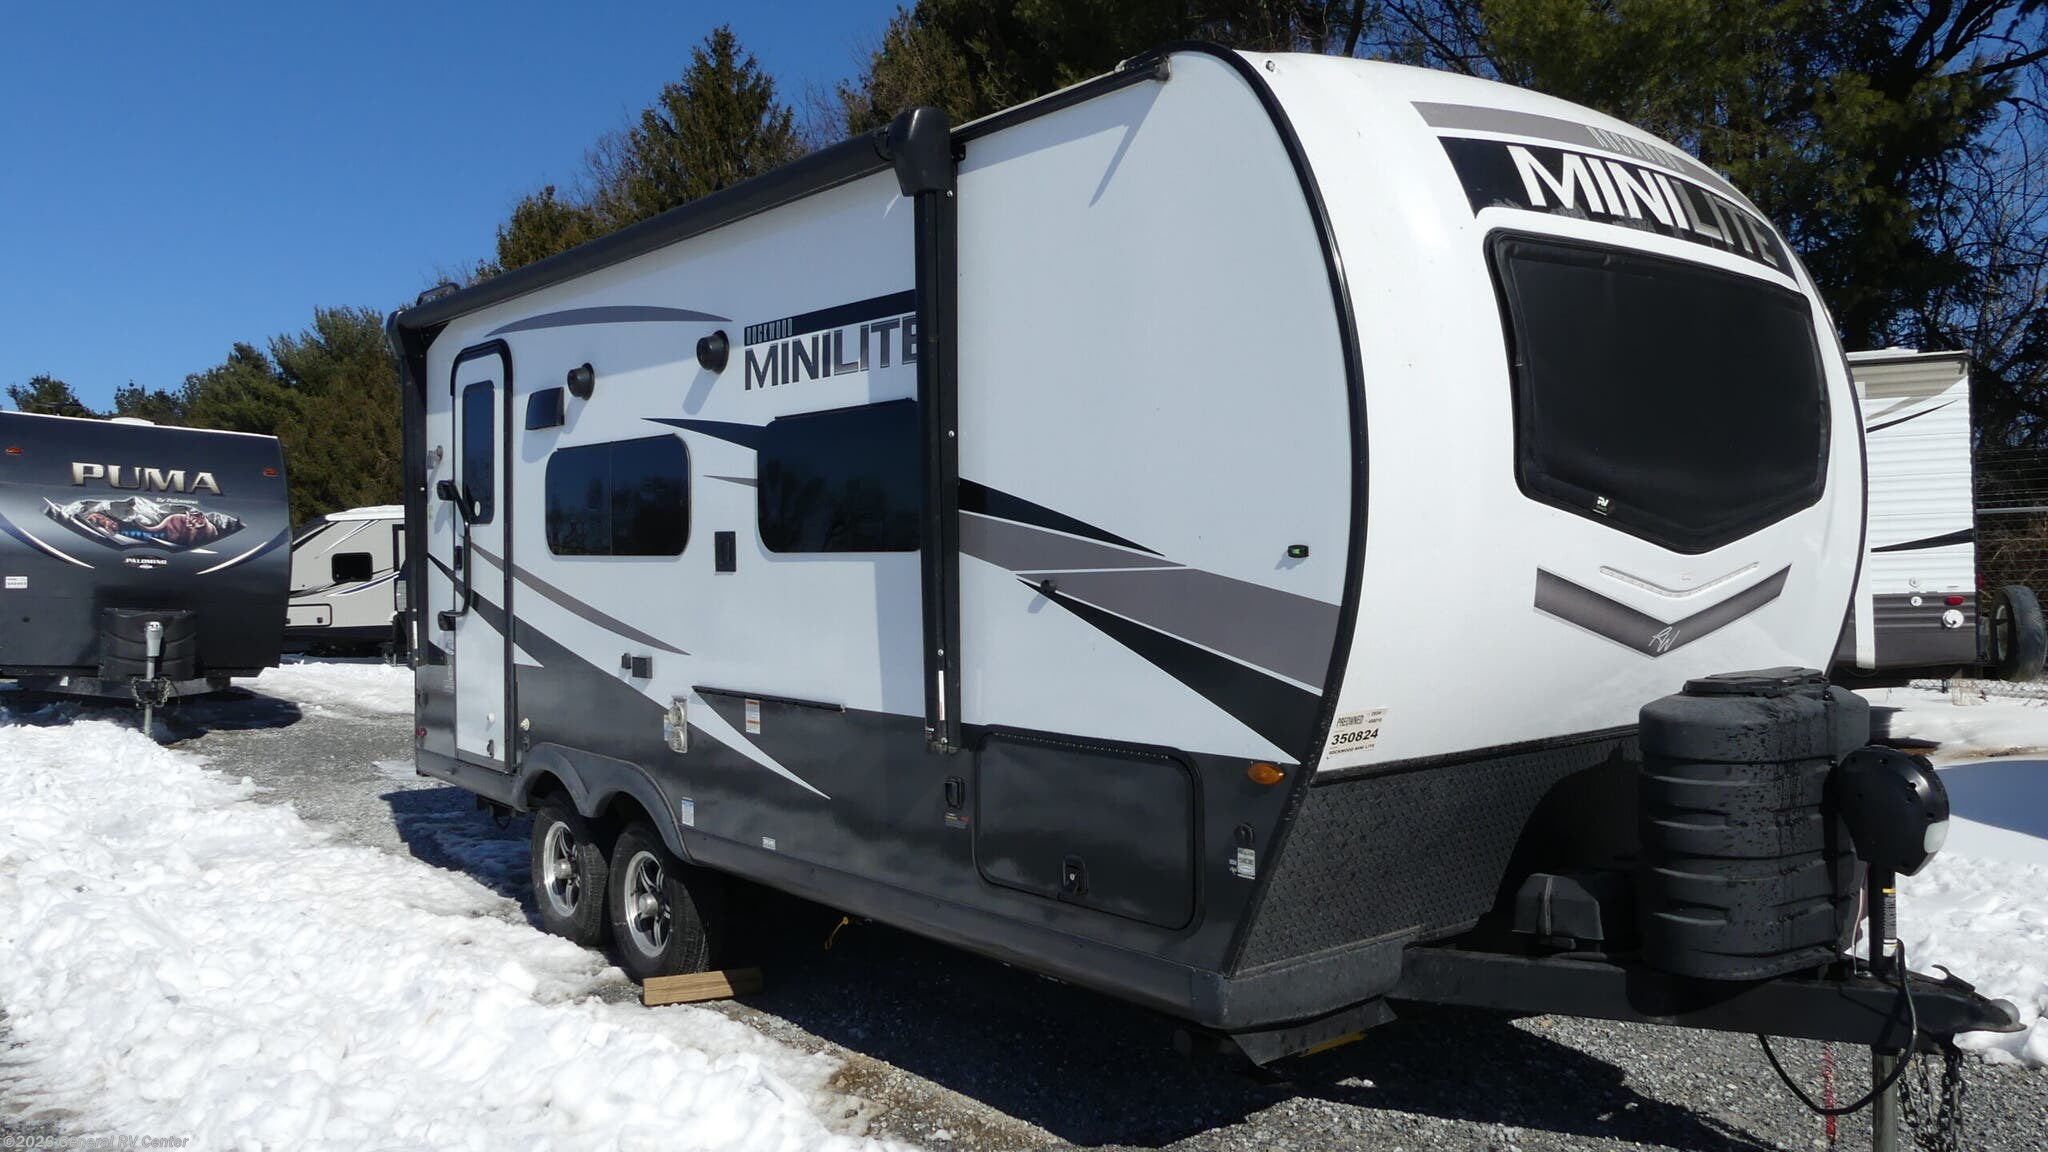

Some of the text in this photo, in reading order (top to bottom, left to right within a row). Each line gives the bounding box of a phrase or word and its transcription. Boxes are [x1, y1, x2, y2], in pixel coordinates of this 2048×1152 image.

[1506, 144, 1779, 268] MINILITE
[746, 318, 793, 345] ROCKWOOD
[72, 461, 224, 496] PUMA
[1331, 728, 1379, 746] 350824
